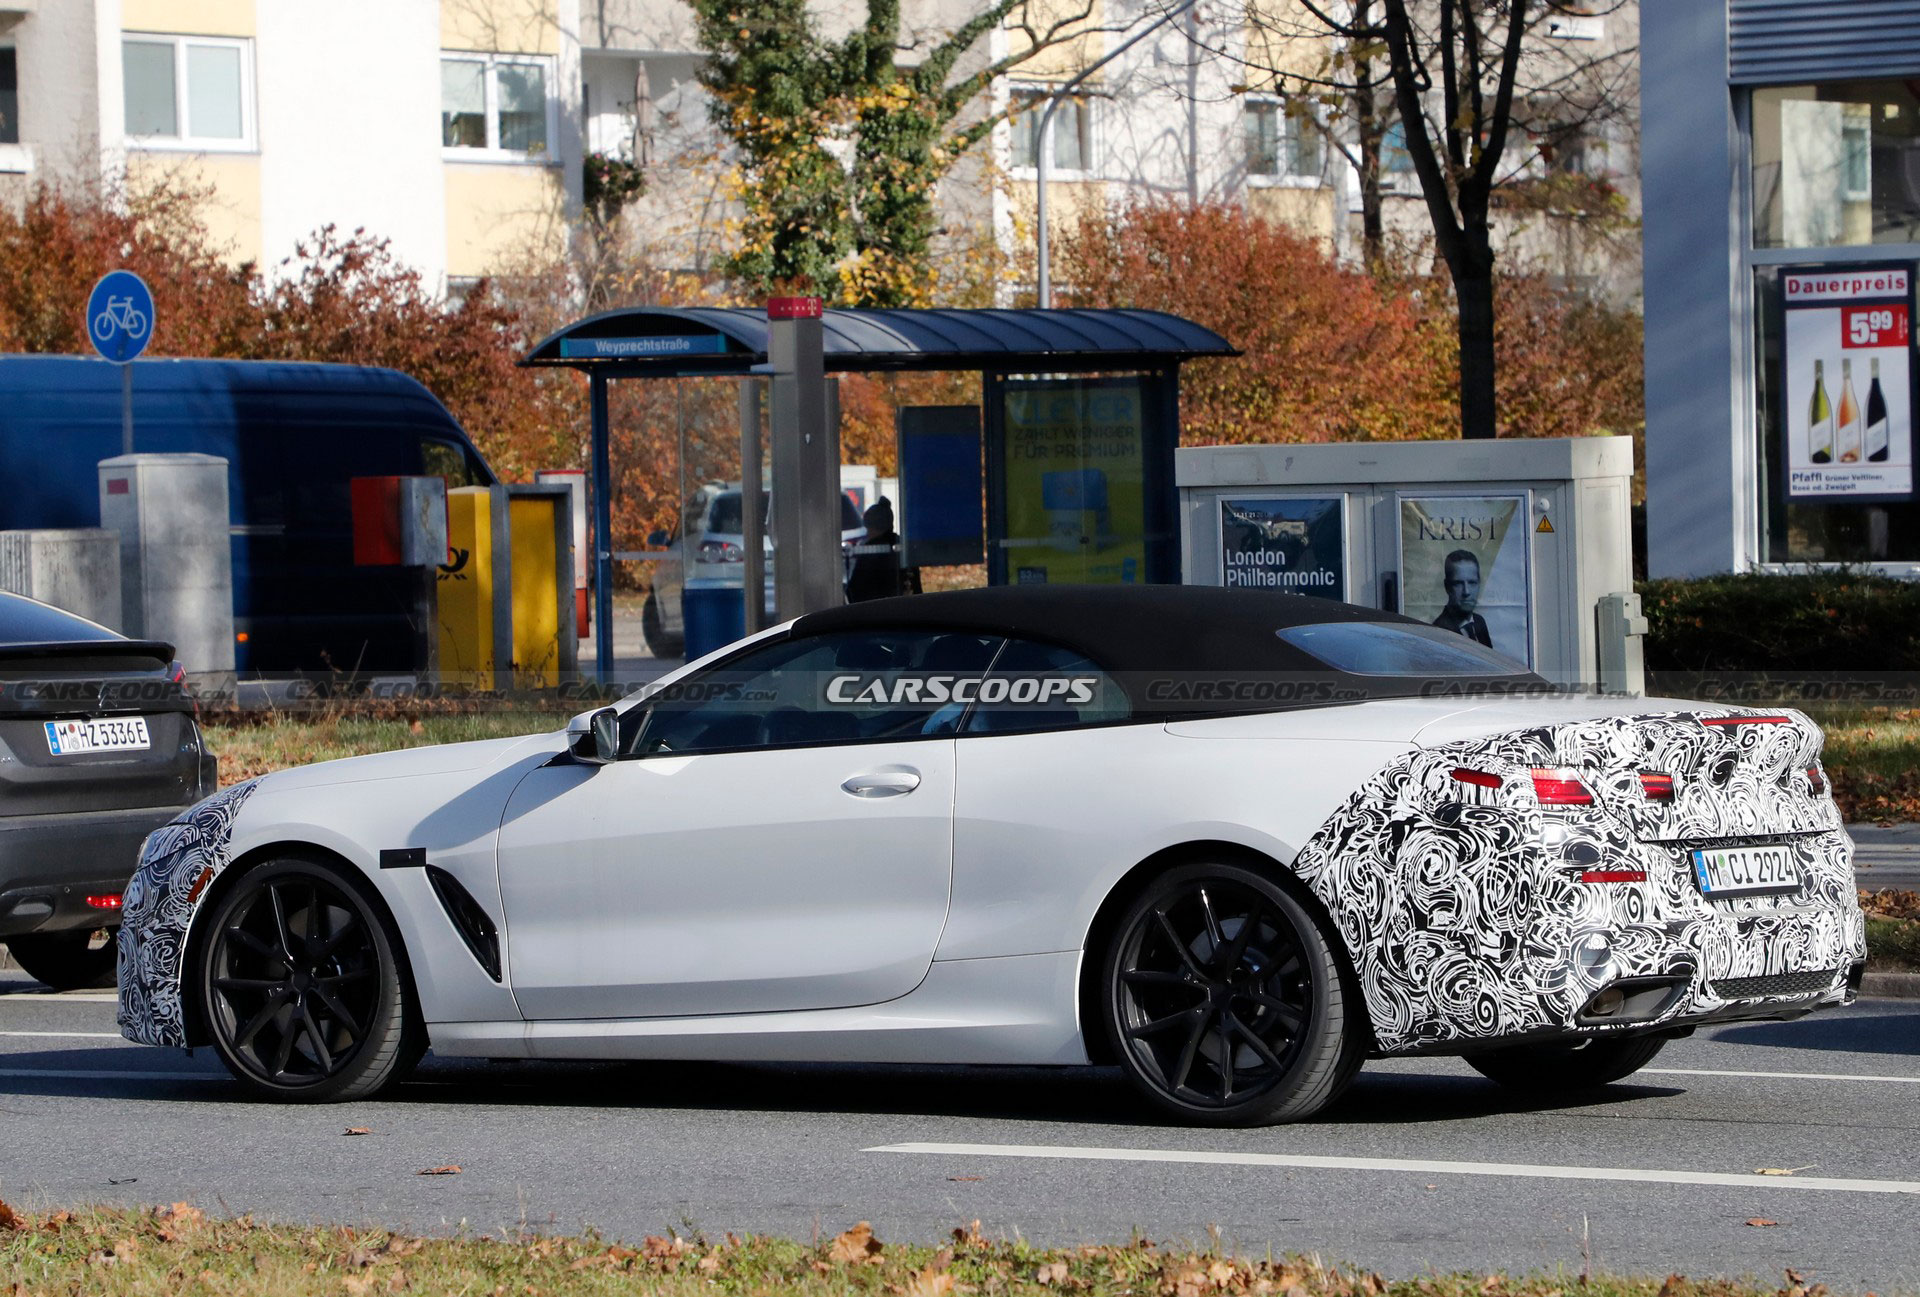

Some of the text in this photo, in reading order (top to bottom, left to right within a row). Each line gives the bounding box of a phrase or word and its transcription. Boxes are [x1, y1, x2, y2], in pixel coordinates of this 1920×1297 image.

[1788, 274, 1905, 294] Dauerpreis
[807, 298, 817, 316] T
[1850, 310, 1893, 344] 5.99
[595, 337, 690, 355] Weyprechtstraße
[1226, 547, 1286, 566] London
[1226, 567, 1336, 587] Philharmonic
[1705, 855, 1722, 887] M
[1754, 851, 1794, 883] 2924
